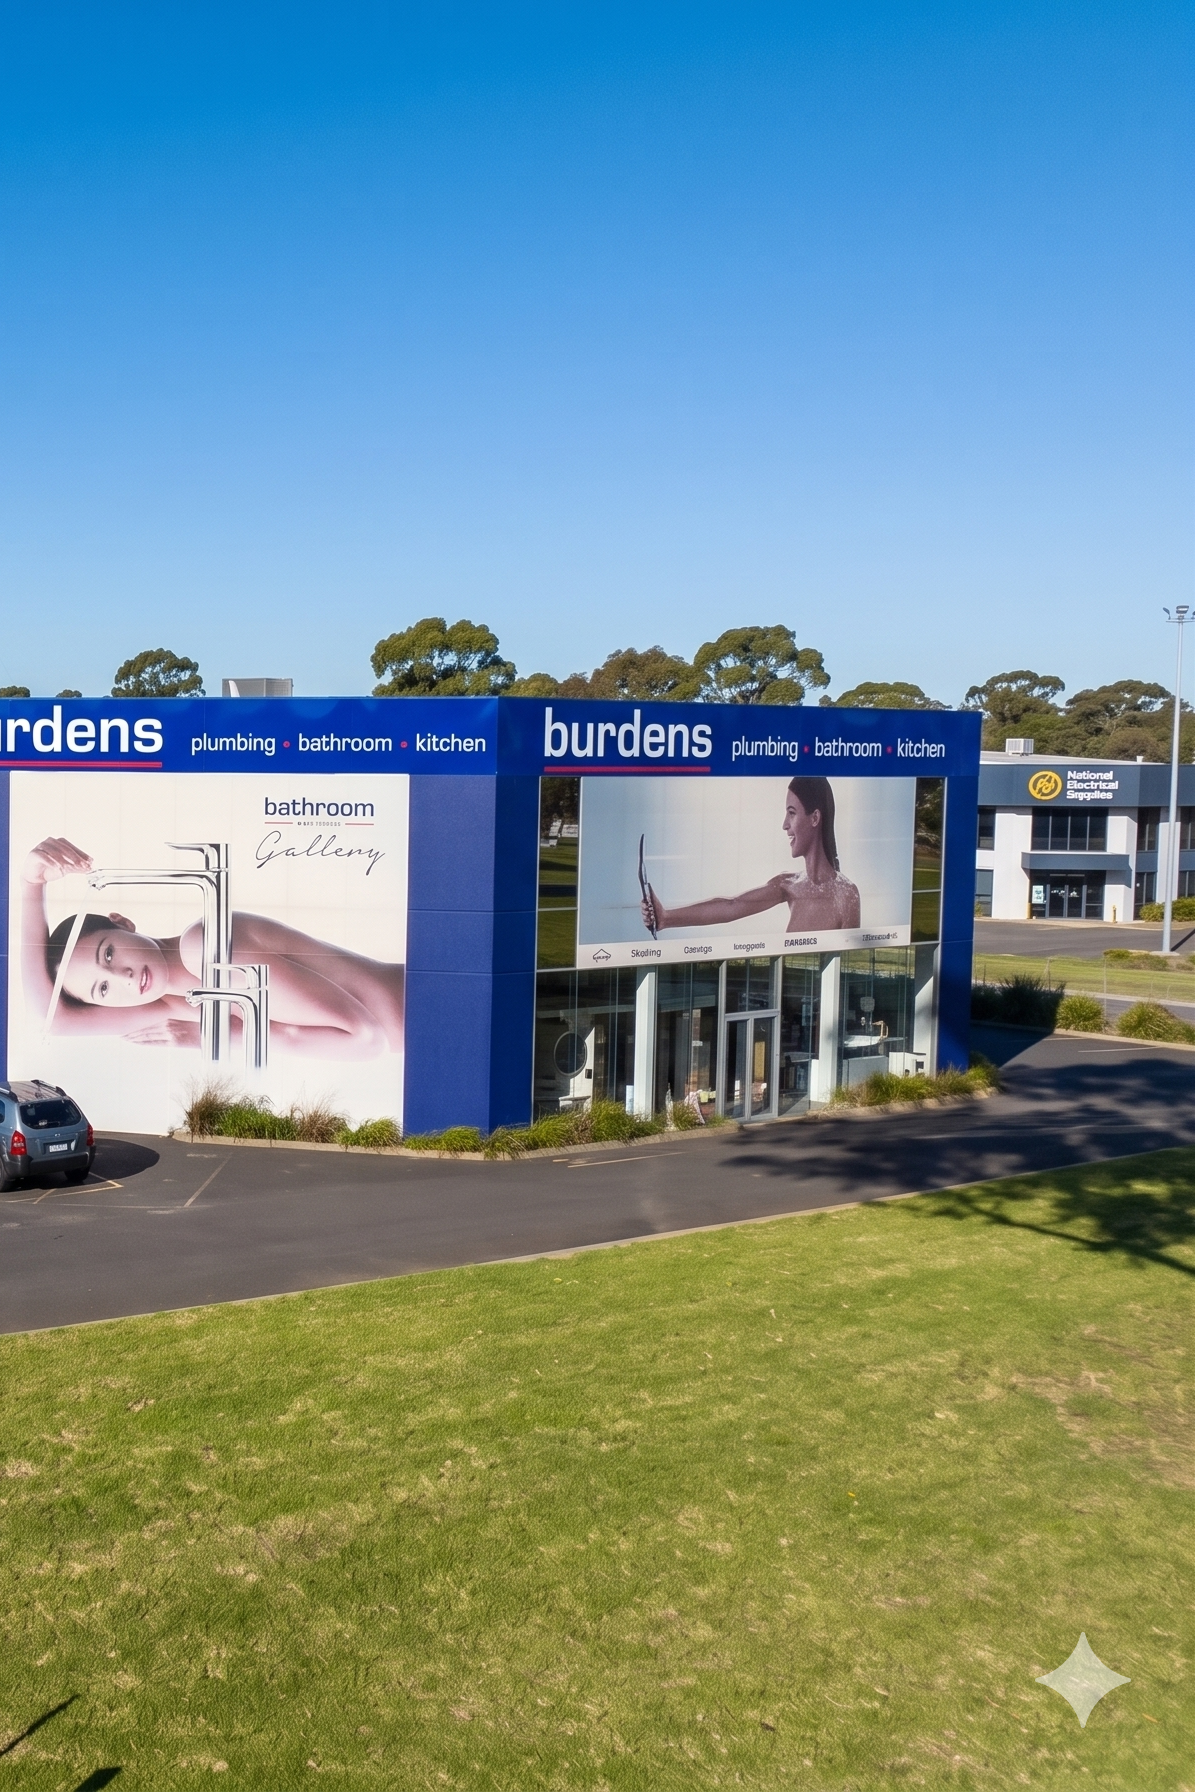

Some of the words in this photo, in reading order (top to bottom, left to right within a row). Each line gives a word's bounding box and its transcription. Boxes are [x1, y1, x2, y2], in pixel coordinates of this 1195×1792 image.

[191, 732, 276, 756] plumbing
[298, 733, 392, 752] bathroom
[416, 733, 486, 752] kitchen
[544, 706, 713, 758] burdens
[732, 735, 799, 762] plumbing
[814, 736, 882, 757] bathroom
[897, 738, 945, 758] kitchen
[264, 796, 375, 817] bathroom
[255, 830, 386, 876] Gallery
